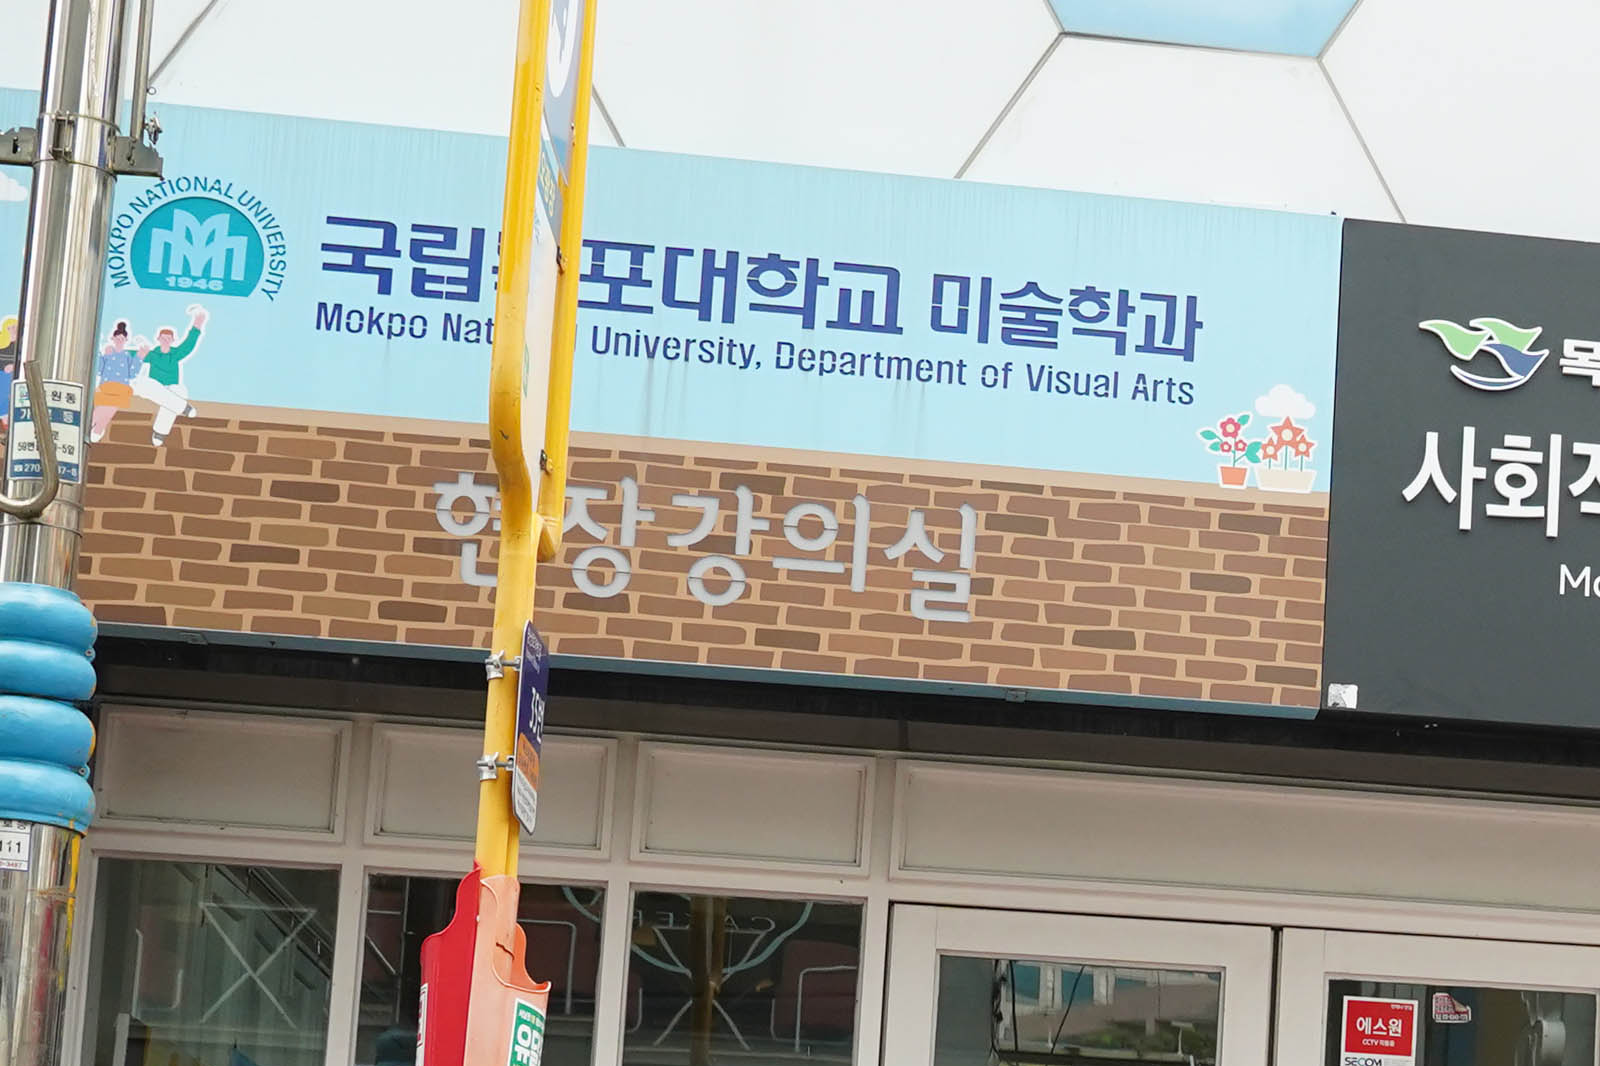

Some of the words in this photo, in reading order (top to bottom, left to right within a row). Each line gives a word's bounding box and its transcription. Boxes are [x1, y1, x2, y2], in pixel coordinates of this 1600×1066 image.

[108, 213, 134, 288] MOKPO
[129, 176, 234, 215] NATIONAL
[238, 190, 287, 302] UNIVERSITY
[165, 275, 224, 291] 1946
[322, 216, 903, 334] 국립포대학교
[931, 274, 1202, 361] 미술학과
[317, 303, 428, 340] Mokpo
[592, 325, 761, 370] University,
[776, 342, 967, 386] Department
[981, 361, 1013, 389] of
[1027, 363, 1120, 399] Visual
[1132, 373, 1195, 406] Arts
[1355, 1016, 1403, 1037] 에스원
[1361, 1038, 1379, 1047] CCTV
